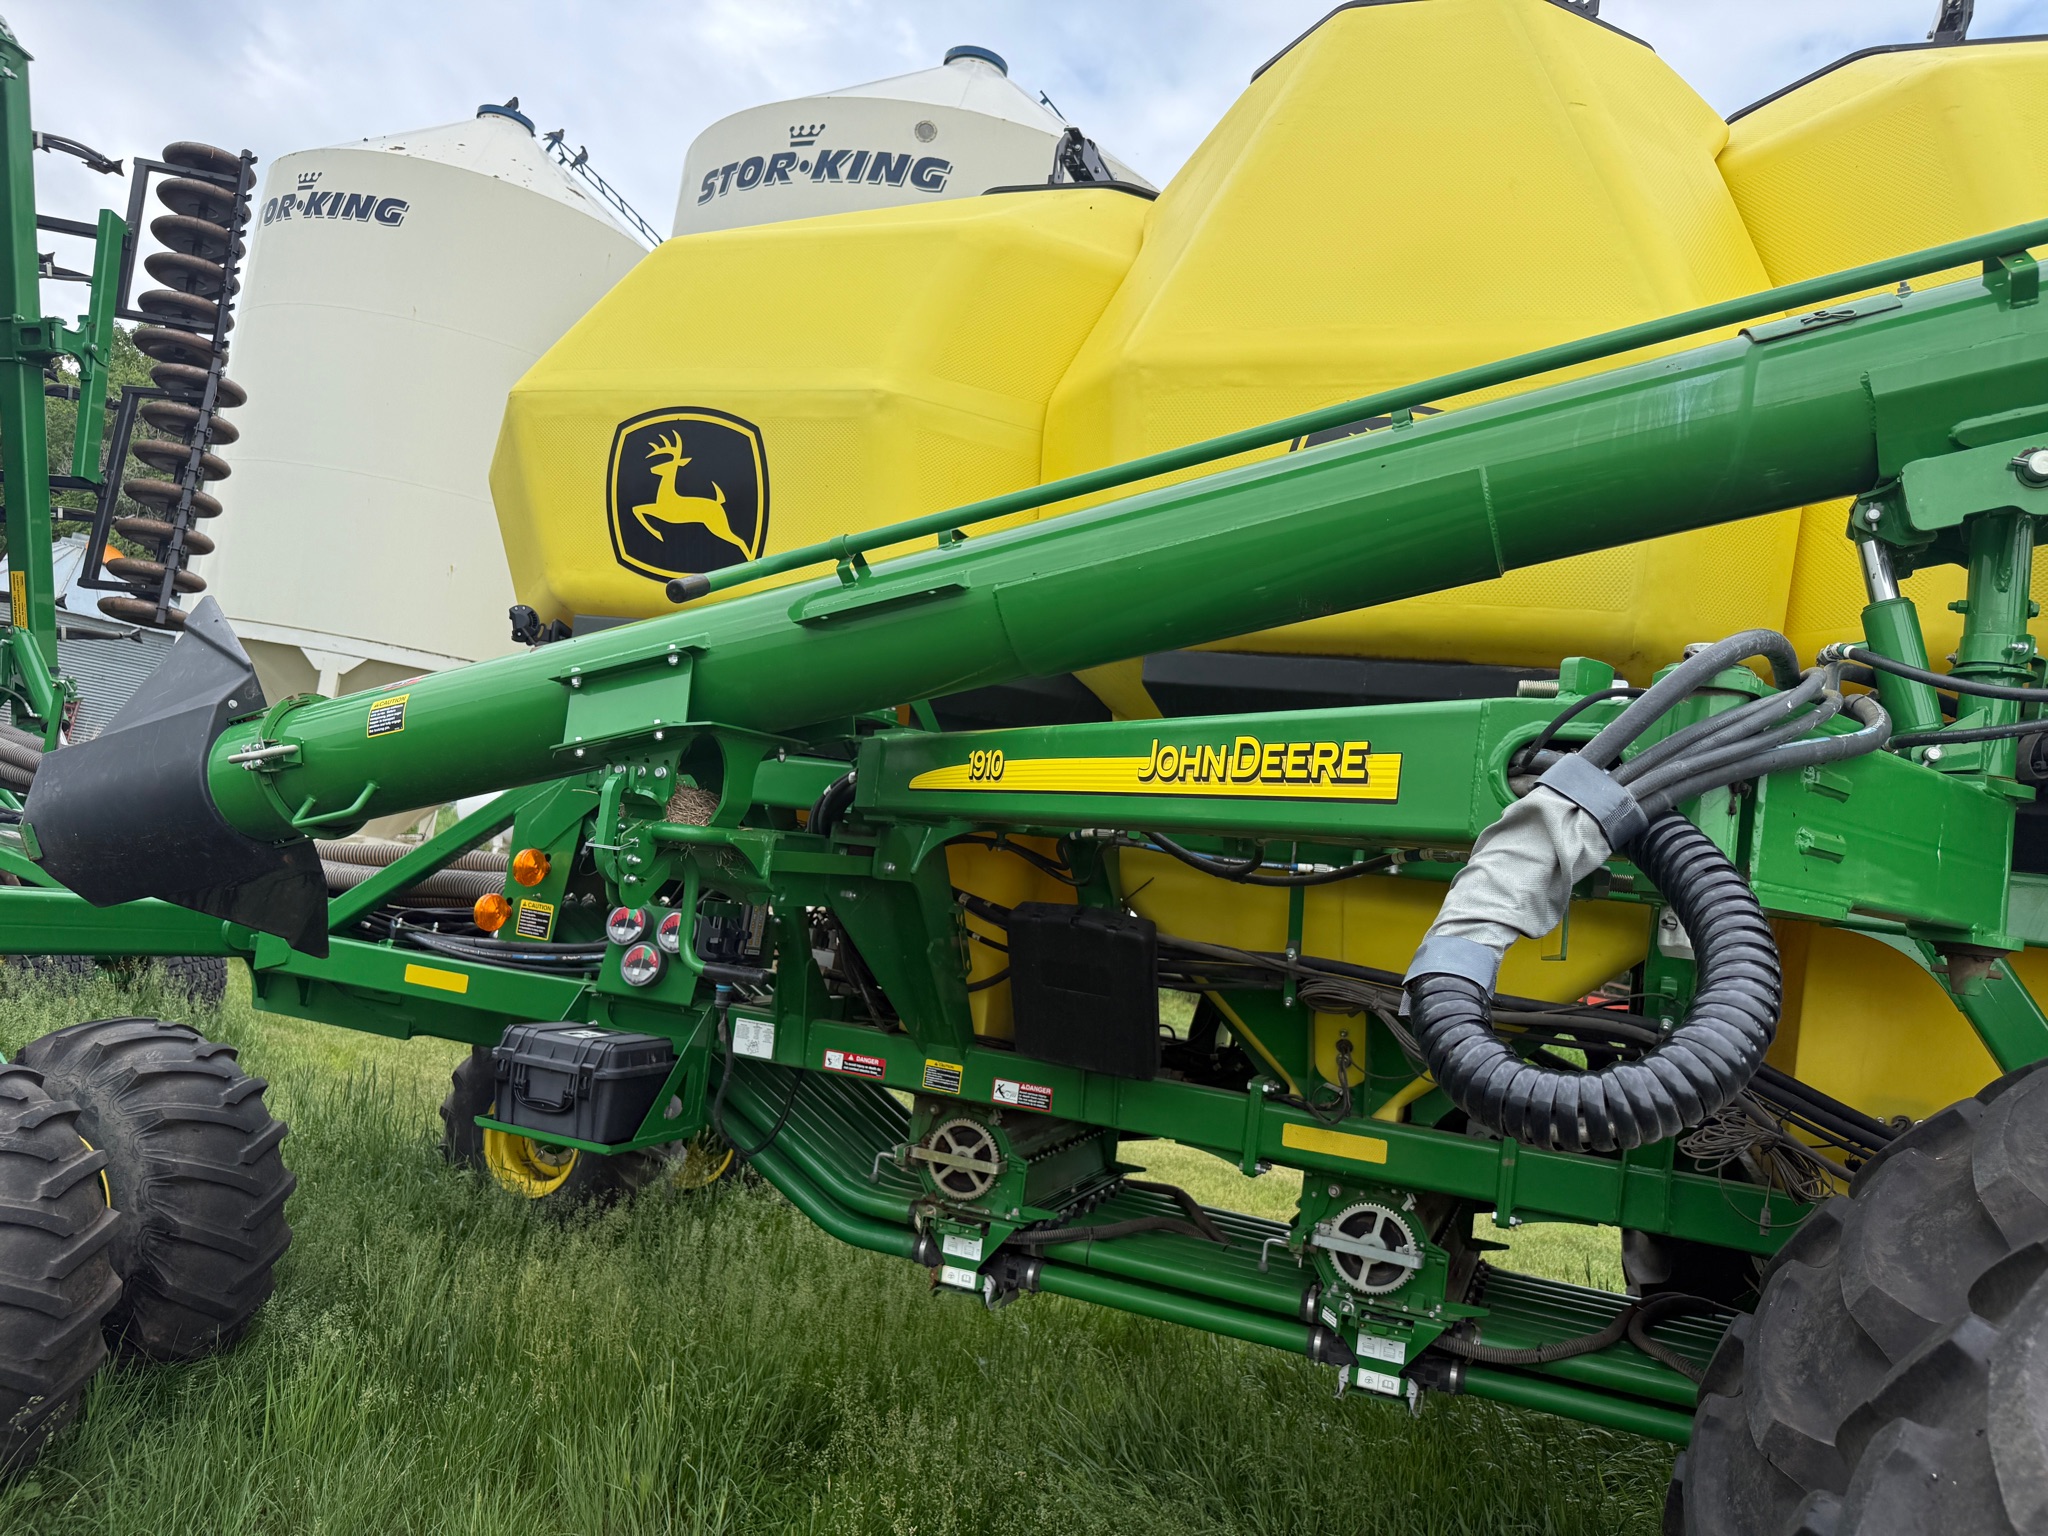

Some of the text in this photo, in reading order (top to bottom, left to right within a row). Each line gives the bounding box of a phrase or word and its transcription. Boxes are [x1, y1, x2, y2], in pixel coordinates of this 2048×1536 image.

[379, 695, 407, 707] CAUTION
[968, 735, 1370, 785] 1910 JOHN DEERE
[527, 902, 552, 911] CAUTION
[856, 1055, 880, 1066] DANGER
[1025, 1084, 1052, 1094] DANGER
